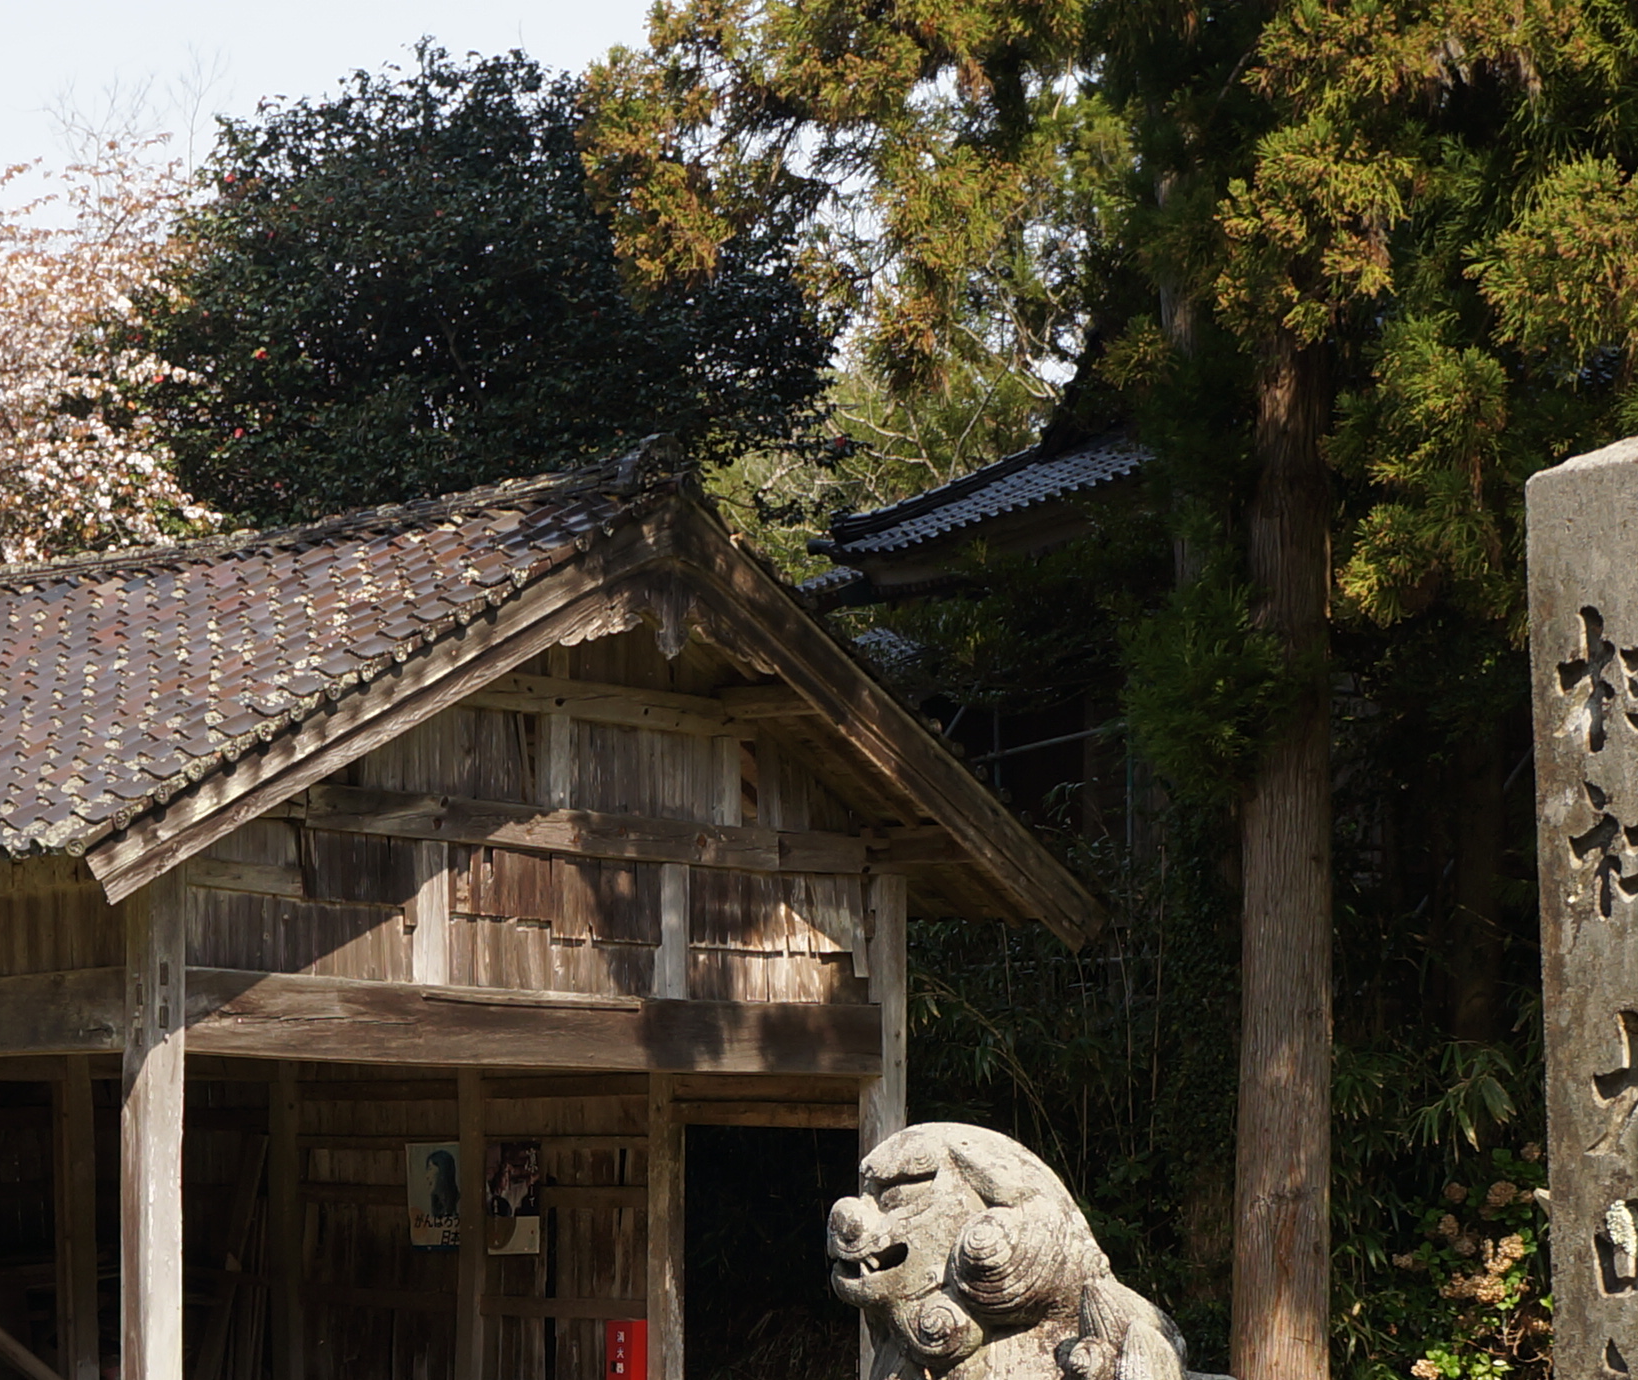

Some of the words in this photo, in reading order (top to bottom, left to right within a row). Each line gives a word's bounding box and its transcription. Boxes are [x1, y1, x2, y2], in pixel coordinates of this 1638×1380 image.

[441, 1230, 461, 1244] 日本
[616, 1330, 625, 1374] 消火器
